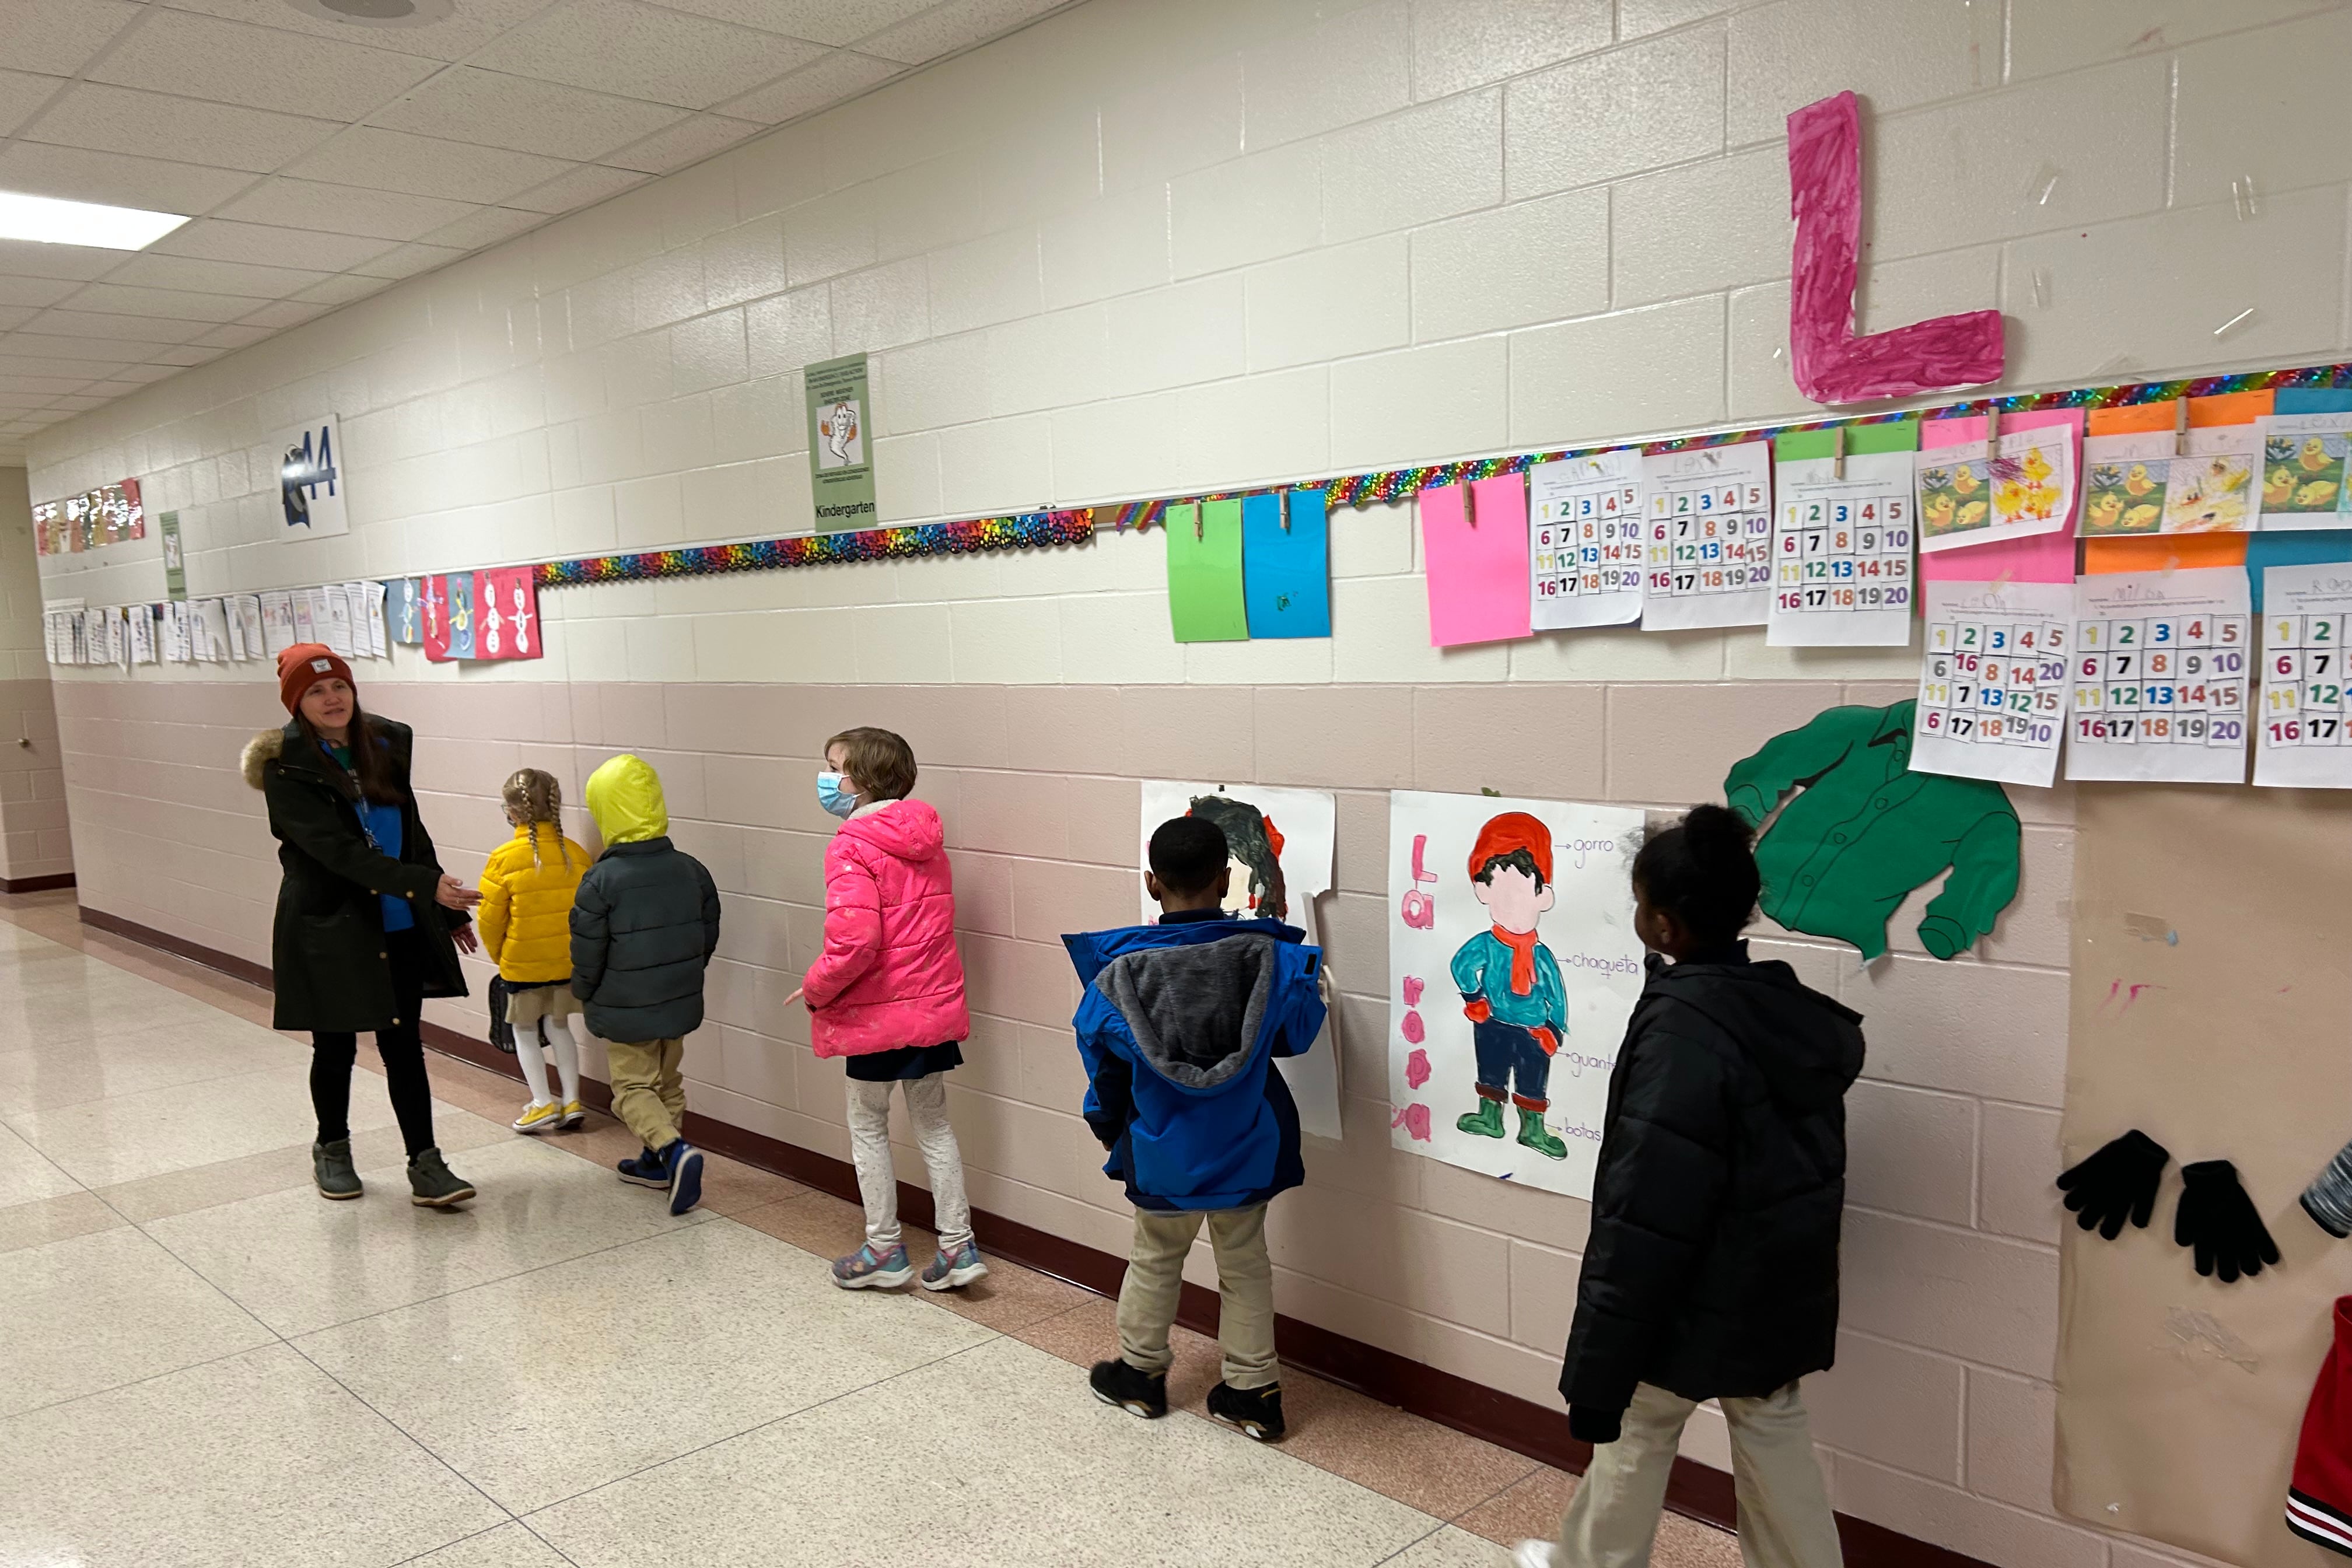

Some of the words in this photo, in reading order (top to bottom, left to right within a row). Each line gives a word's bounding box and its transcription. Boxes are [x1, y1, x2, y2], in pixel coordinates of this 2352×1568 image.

[1787, 89, 2005, 404] L
[816, 501, 874, 518] Kindergarten
[1541, 504, 1549, 519] 1
[1560, 501, 1570, 516] 2
[1581, 500, 1591, 515] 3
[1606, 497, 1617, 512] 4
[1624, 488, 1634, 504] 5
[1655, 497, 1665, 513] 1
[1678, 496, 1689, 512] 2
[1700, 494, 1712, 510] 3
[1723, 491, 1735, 506] 4
[1749, 488, 1760, 504] 5
[1787, 506, 1797, 523] 1
[1809, 505, 1821, 521] 2
[1836, 505, 1848, 522] 3
[1861, 503, 1875, 520] 4
[1889, 502, 1902, 520] 5
[1541, 530, 1550, 545] 6
[1560, 527, 1570, 542] 7
[1583, 523, 1594, 538] 8
[1605, 523, 1615, 539] 9
[1621, 523, 1639, 538] 10
[1654, 524, 1665, 540] 6
[1678, 520, 1688, 536] 7
[1704, 520, 1716, 537] 8
[1726, 519, 1738, 536] 9
[1746, 517, 1766, 533] 10
[1650, 546, 1668, 562] 11
[1675, 545, 1695, 560] 12
[1699, 542, 1720, 559] 13
[1725, 544, 1745, 559] 14
[1746, 545, 1767, 562] 15
[1784, 536, 1795, 552] 6
[1809, 535, 1820, 551] 7
[1835, 531, 1848, 548] 8
[1863, 533, 1875, 550] 9
[1885, 530, 1909, 547] 10
[1537, 554, 1553, 569] 11
[1558, 552, 1576, 568] 12
[1581, 547, 1598, 562] 13
[1603, 545, 1620, 559] 14
[1624, 544, 1642, 559] 15
[1648, 572, 1671, 588] 16
[1675, 575, 1695, 590] 17
[1702, 571, 1723, 586] 18
[1726, 569, 1745, 585] 19
[1749, 566, 1770, 582] 20
[1780, 565, 1800, 581] 11
[1805, 561, 1826, 578] 12
[1831, 561, 1853, 578] 13
[1857, 560, 1881, 578] 14
[1883, 559, 1908, 576] 15
[1538, 580, 1556, 596] 16
[1559, 577, 1577, 592] 17
[1581, 574, 1599, 589] 18
[1602, 570, 1619, 585] 19
[1622, 571, 1640, 586] 20
[1779, 593, 1801, 608] 16
[1805, 589, 1826, 606] 17
[1832, 589, 1853, 606] 18
[1858, 588, 1881, 604] 19
[1884, 586, 1909, 604] 20
[1936, 629, 1947, 646] 1
[1963, 628, 1976, 645] 2
[1992, 631, 2005, 649] 3
[2020, 631, 2034, 649] 4
[2048, 629, 2064, 647] 5
[2085, 626, 2098, 645] 1
[2119, 625, 2134, 644] 2
[2155, 624, 2170, 642] 3
[2187, 621, 2204, 639] 4
[2222, 624, 2238, 643] 5
[2277, 621, 2290, 641] 1
[2314, 621, 2330, 640] 2
[1955, 653, 1978, 671] 16
[1985, 663, 1999, 681] 8
[2011, 667, 2036, 685] 14
[2039, 663, 2063, 680] 20
[2082, 658, 2097, 676] 6
[2116, 656, 2131, 674] 7
[2151, 654, 2167, 673] 8
[2186, 655, 2202, 674] 9
[2211, 652, 2244, 673] 10
[2276, 655, 2292, 675] 6
[2314, 654, 2330, 674] 7
[1926, 684, 1947, 701] 11
[1958, 685, 1970, 703] 7
[1980, 688, 2003, 706] 13
[2009, 693, 2032, 713] 12
[2034, 692, 2057, 710] 15
[2075, 689, 2100, 706] 11
[2110, 687, 2138, 705] 12
[2146, 686, 2174, 705] 13
[2177, 685, 2206, 704] 14
[2208, 686, 2240, 707] 15
[2267, 689, 2295, 710] 11
[2309, 684, 2339, 704] 12
[1927, 712, 1941, 729] 6
[1951, 717, 1973, 736] 17
[1979, 720, 2003, 736] 18
[2006, 717, 2029, 734] 19
[2029, 724, 2052, 742] 10
[2079, 719, 2105, 737] 16
[2107, 720, 2134, 737] 17
[2140, 718, 2169, 737] 18
[2177, 719, 2205, 737] 19
[2211, 720, 2242, 740] 20
[2269, 720, 2300, 741] 16
[2308, 719, 2337, 738] 17
[1574, 839, 1614, 869] gorro
[1572, 952, 1639, 979] chaqueta
[1564, 1116, 1602, 1142] botas
